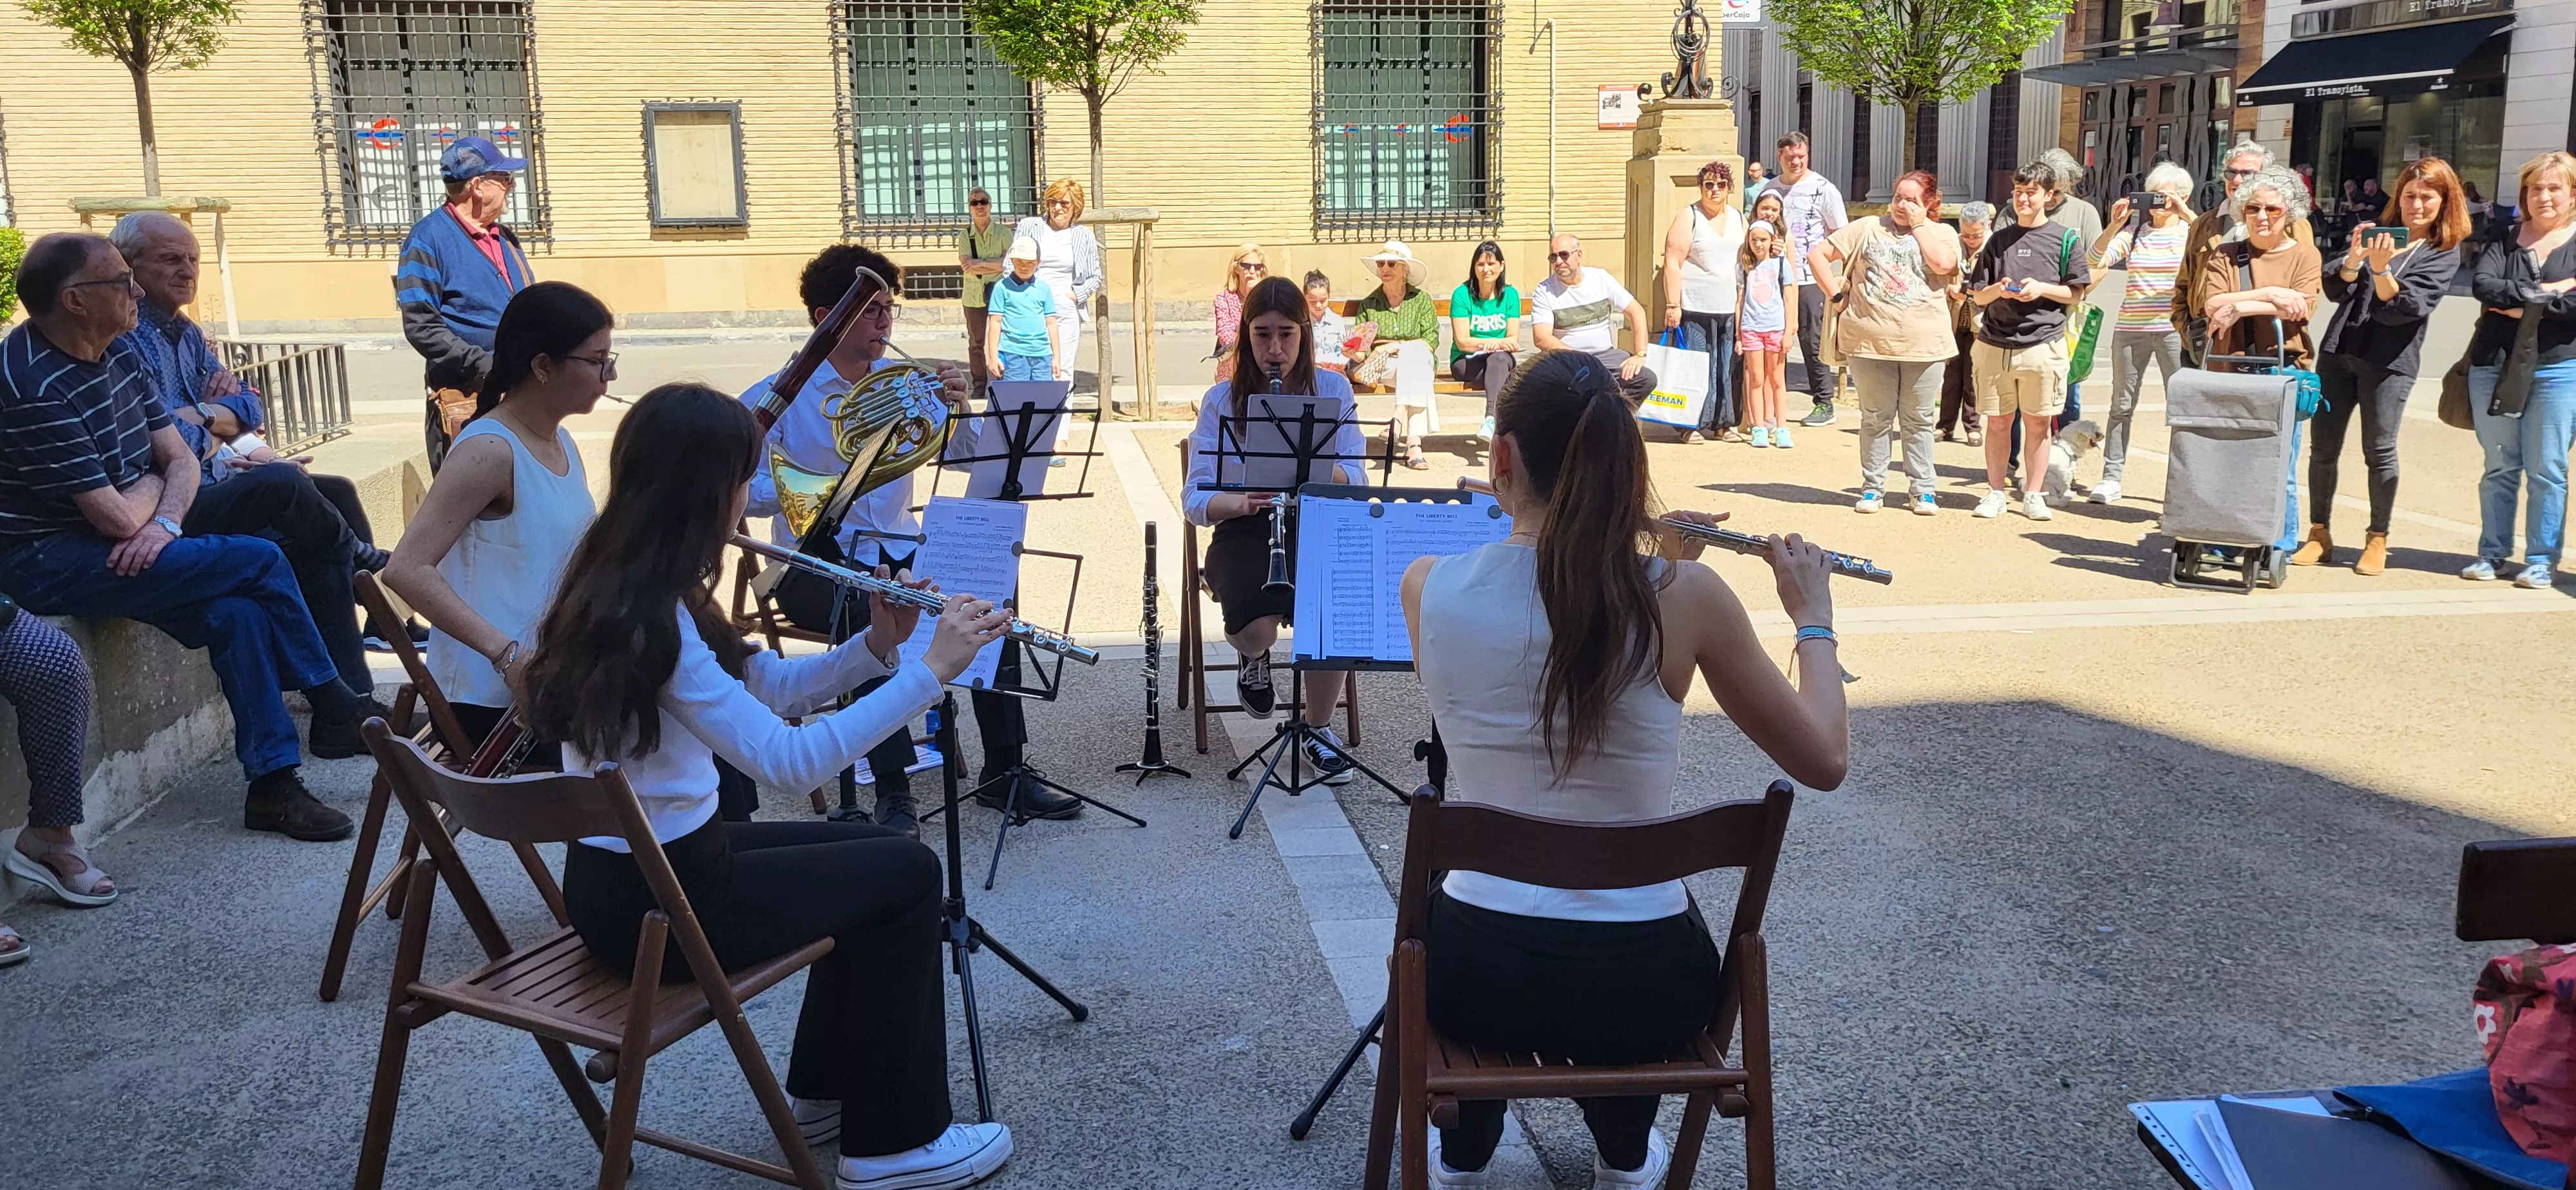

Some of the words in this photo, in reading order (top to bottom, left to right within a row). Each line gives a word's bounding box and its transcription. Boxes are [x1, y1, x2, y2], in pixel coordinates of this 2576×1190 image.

[2409, 1, 2421, 12] El
[2305, 88, 2315, 97] El
[2317, 84, 2363, 95] Tramoyista
[1470, 313, 1506, 332] PARIS
[1646, 393, 1683, 406] EEMAN
